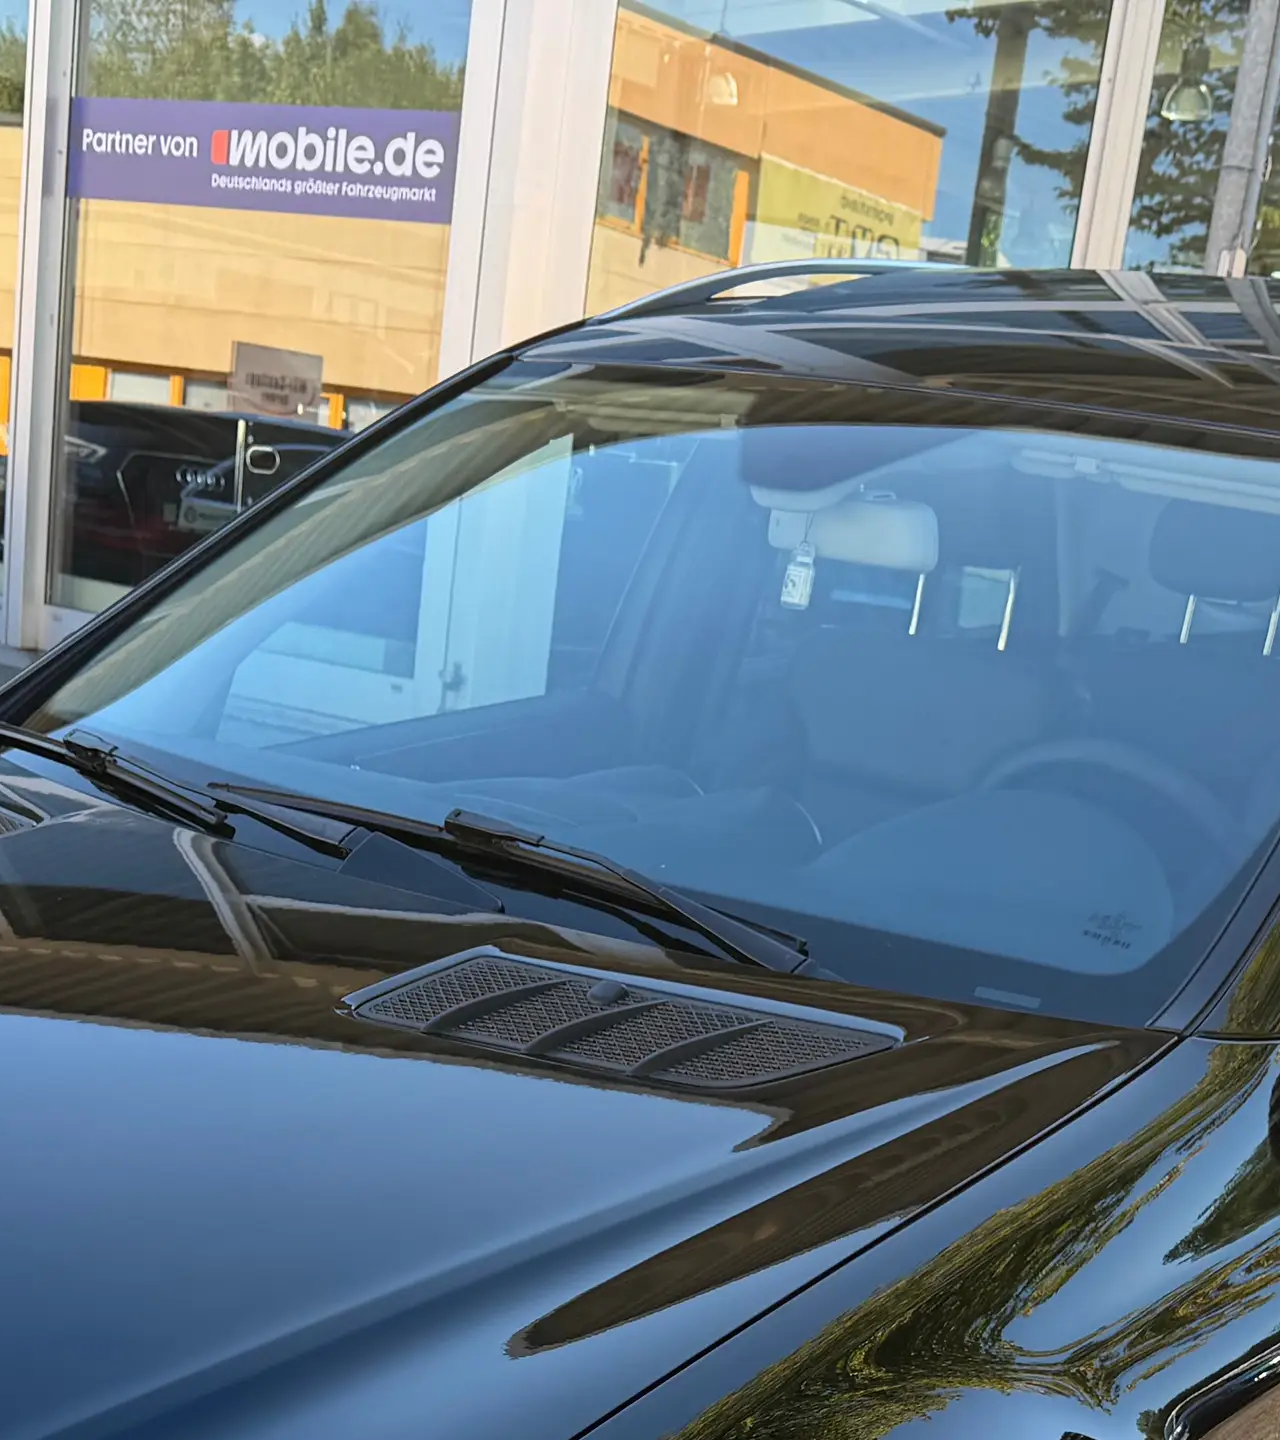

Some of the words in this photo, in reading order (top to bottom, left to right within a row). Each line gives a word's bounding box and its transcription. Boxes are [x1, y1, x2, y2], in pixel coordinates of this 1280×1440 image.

[82, 128, 157, 156] Partner
[160, 135, 198, 158] von
[229, 126, 445, 178] mobile.de
[211, 173, 292, 193] Deutschlands
[294, 177, 340, 196] größter
[341, 181, 436, 202] Fahrzeugmarkt
